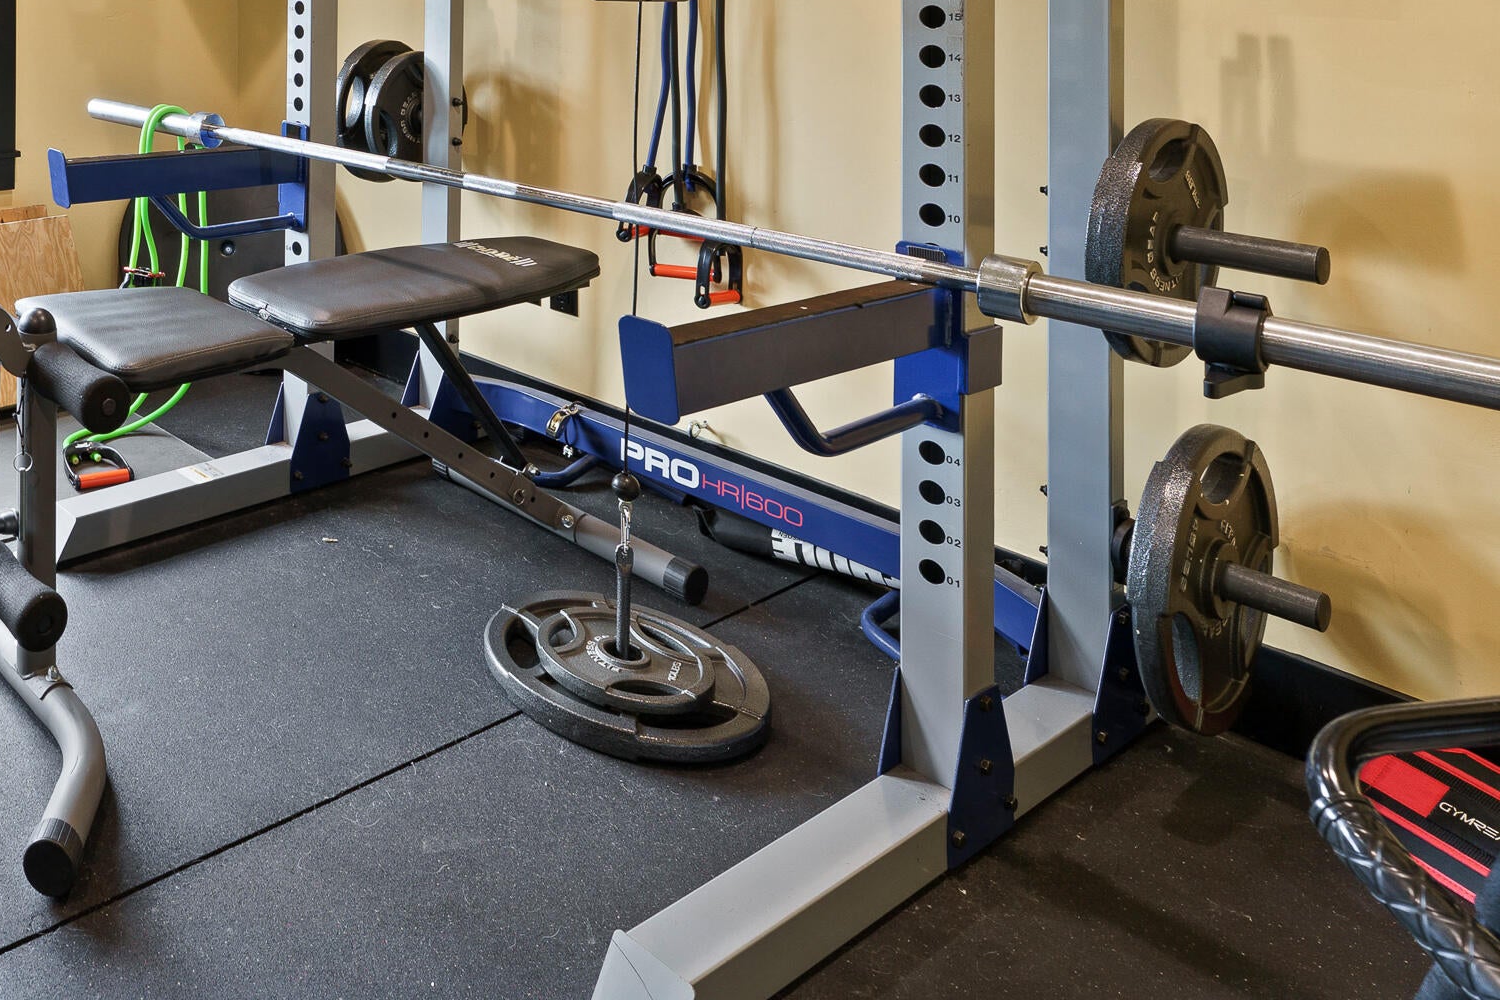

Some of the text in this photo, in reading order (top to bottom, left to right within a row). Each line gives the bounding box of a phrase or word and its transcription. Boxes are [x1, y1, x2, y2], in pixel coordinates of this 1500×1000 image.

[948, 13, 961, 21] 15
[948, 53, 961, 62] 14
[948, 94, 961, 103] 13
[947, 134, 961, 143] 12
[947, 174, 959, 183] 11
[947, 214, 961, 224] 10
[620, 437, 700, 490] PRO
[946, 455, 961, 467] 04
[946, 495, 961, 508] 03
[946, 535, 962, 548] 02
[946, 576, 960, 588] 01
